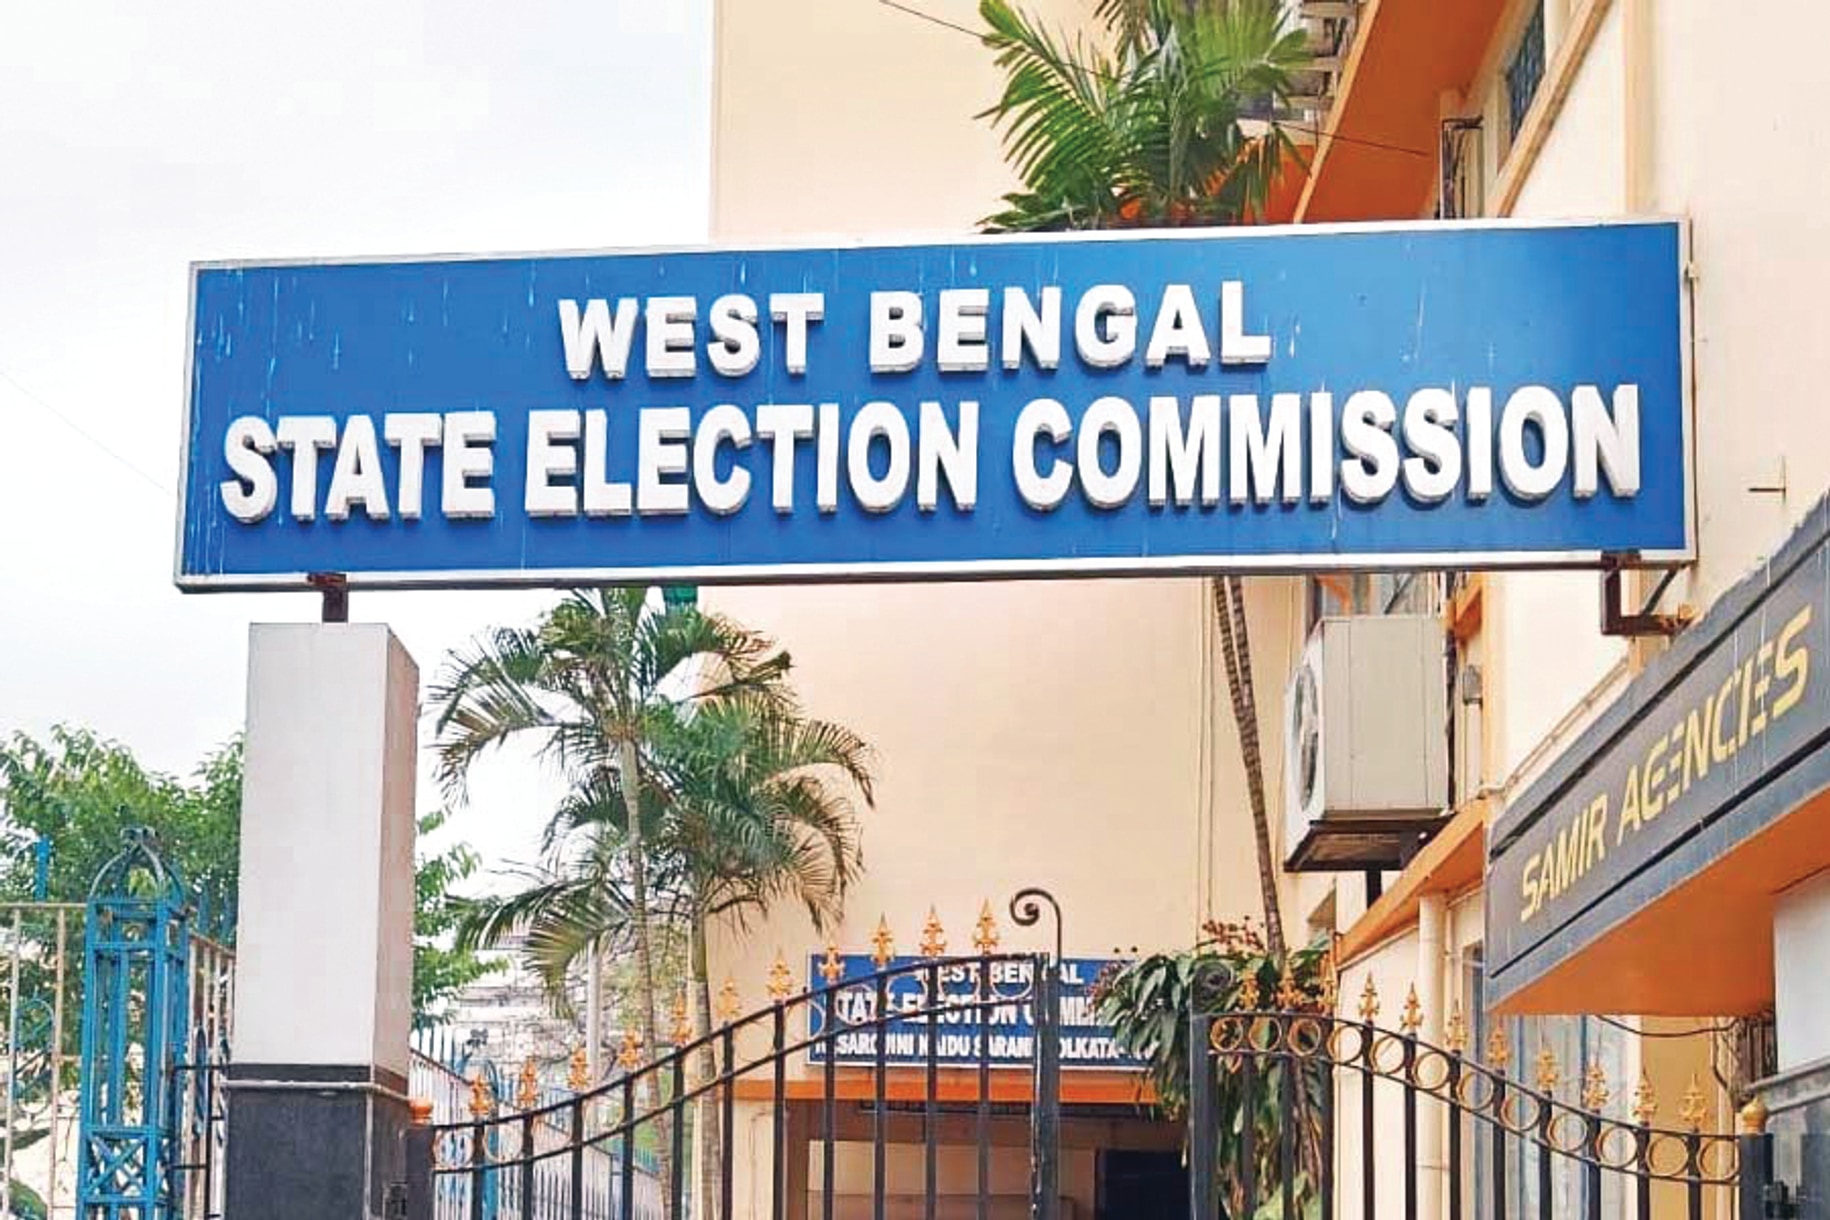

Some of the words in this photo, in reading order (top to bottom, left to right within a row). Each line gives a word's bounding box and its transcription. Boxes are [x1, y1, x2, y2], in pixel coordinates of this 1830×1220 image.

[558, 293, 825, 380] WEST
[869, 279, 1272, 375] BENGAL
[220, 410, 497, 523] STATE
[524, 400, 980, 517] ELECTION
[1012, 383, 1641, 511] COMMISSION
[1520, 793, 1608, 923] SAMIR
[1616, 602, 1813, 847] AGENCIES
